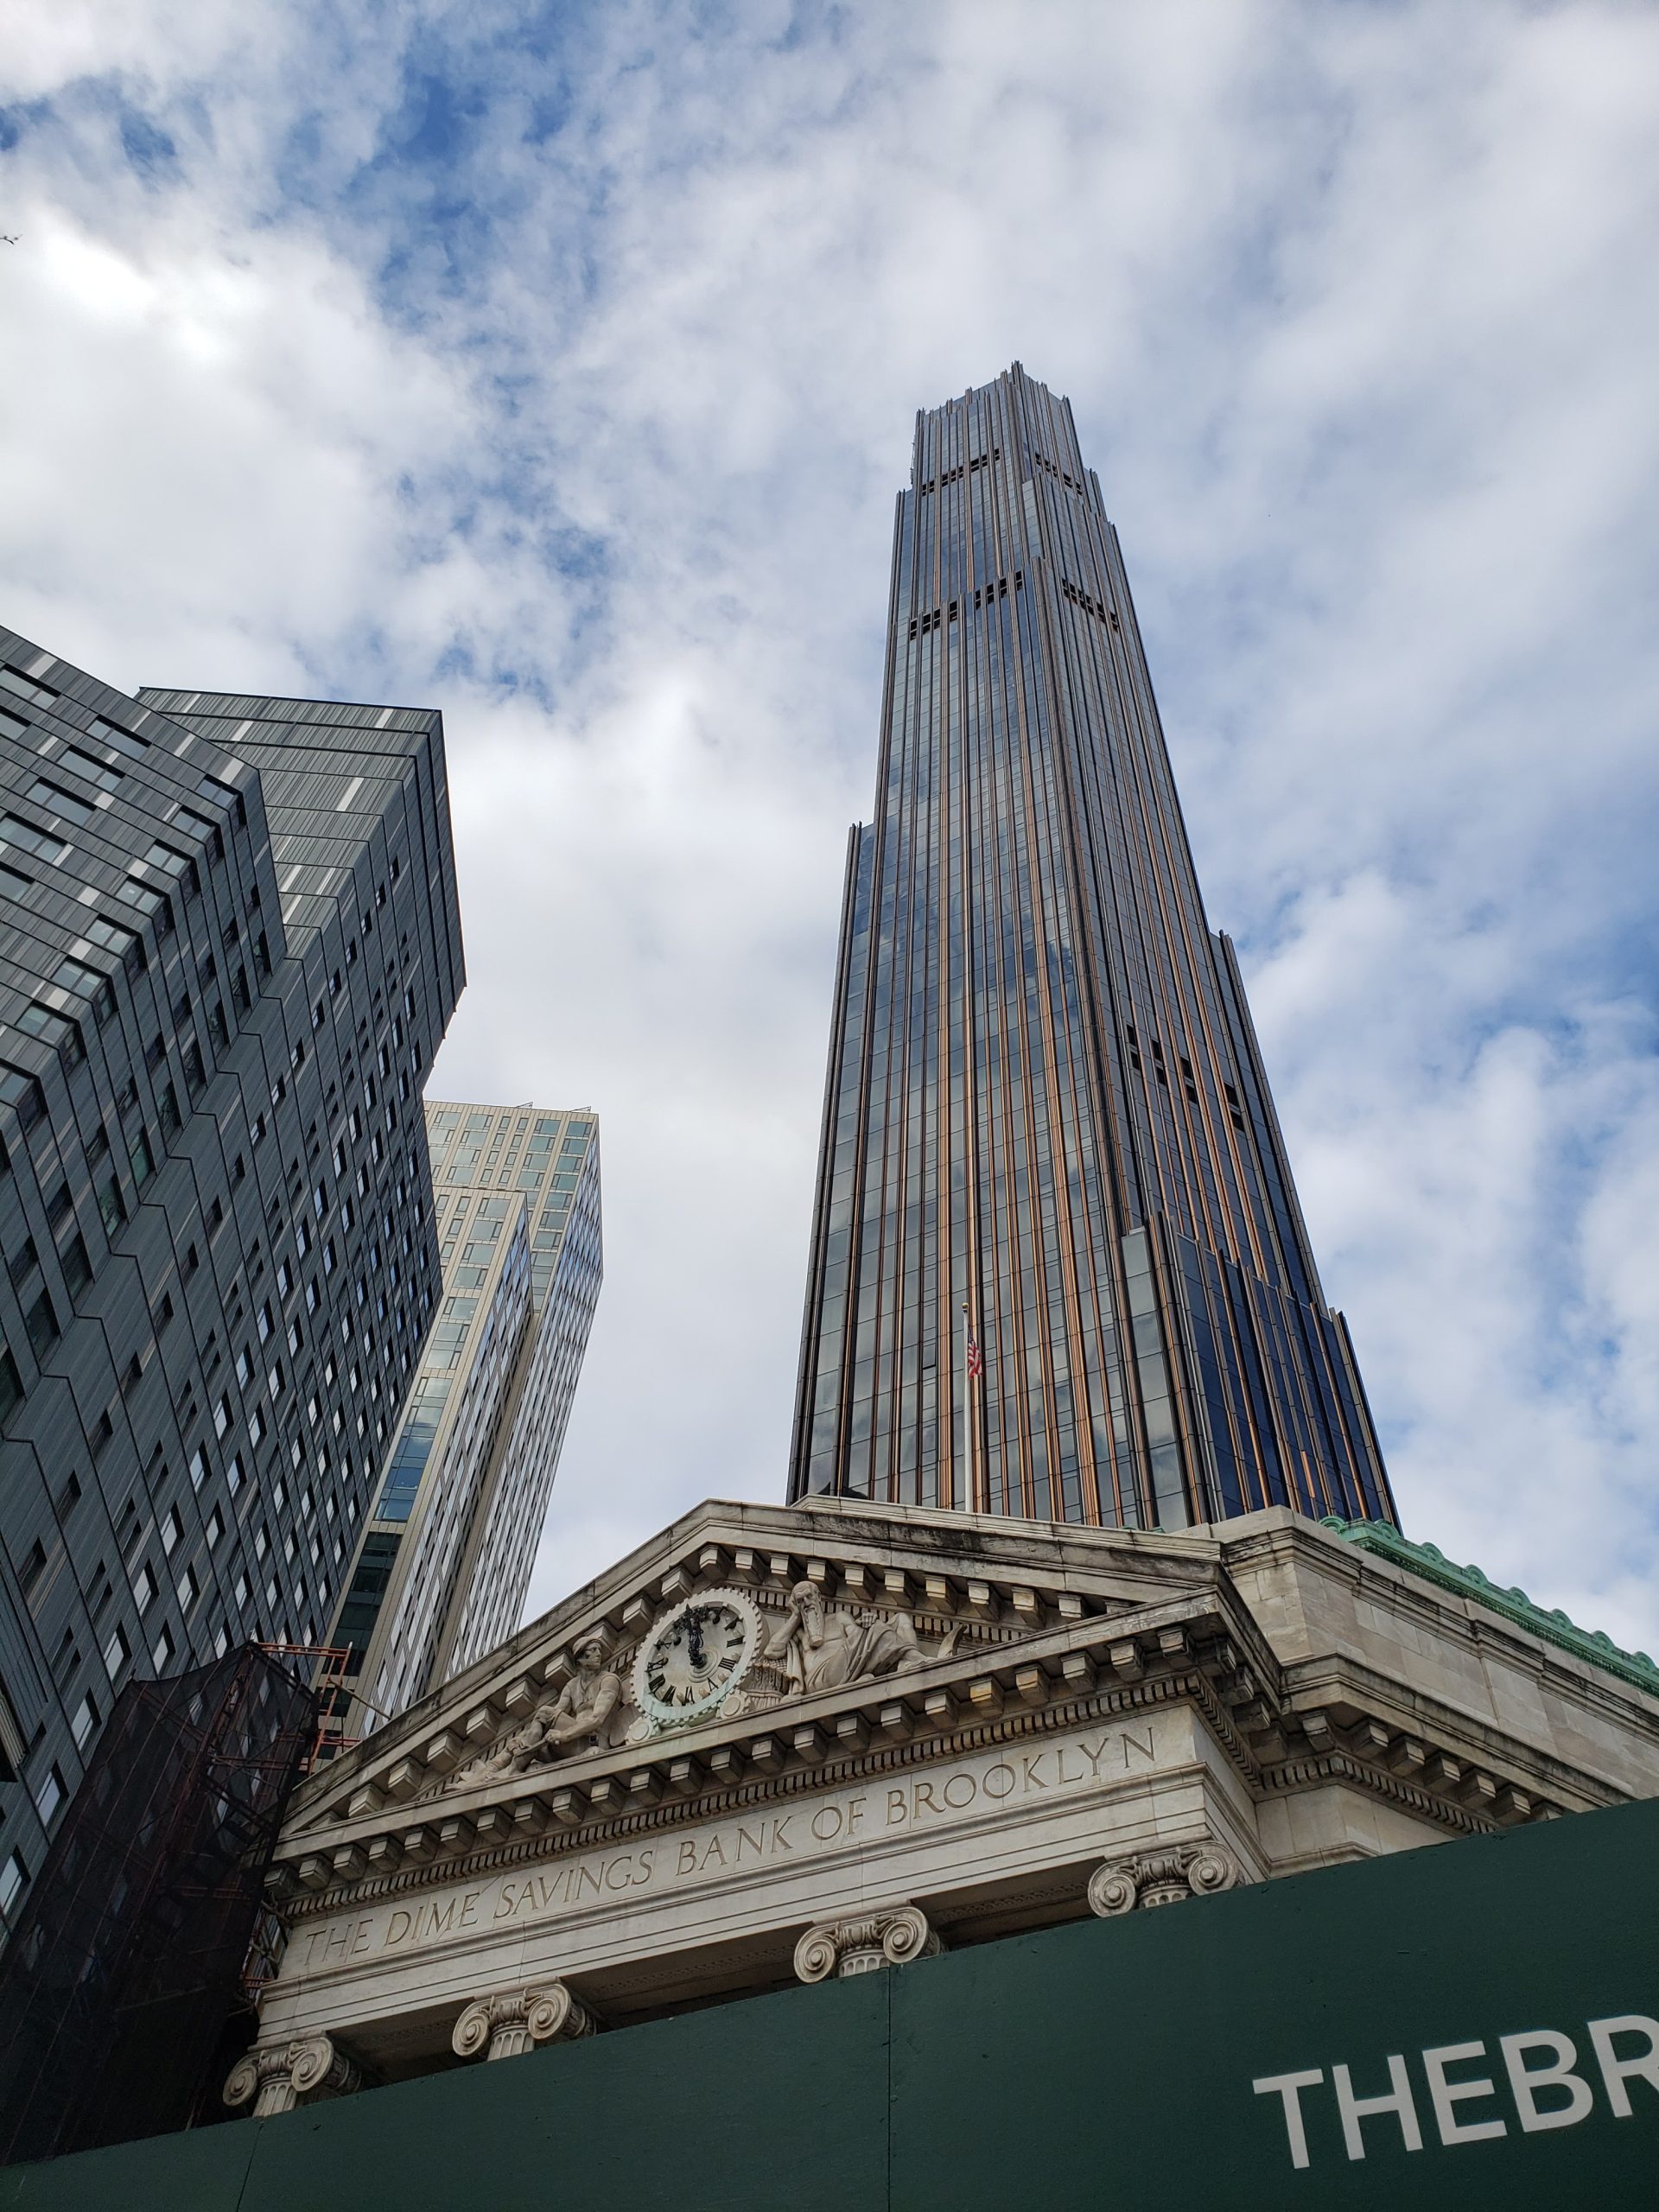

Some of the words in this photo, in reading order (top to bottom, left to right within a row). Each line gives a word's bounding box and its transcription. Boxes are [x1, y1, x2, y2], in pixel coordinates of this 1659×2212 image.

[304, 1917, 372, 1966] THE
[385, 1891, 480, 1946] DIME
[493, 1851, 654, 1919] SAVINGS
[677, 1815, 793, 1875] BANK
[810, 1798, 867, 1840] OF
[886, 1726, 1156, 1826] BROOKLYN
